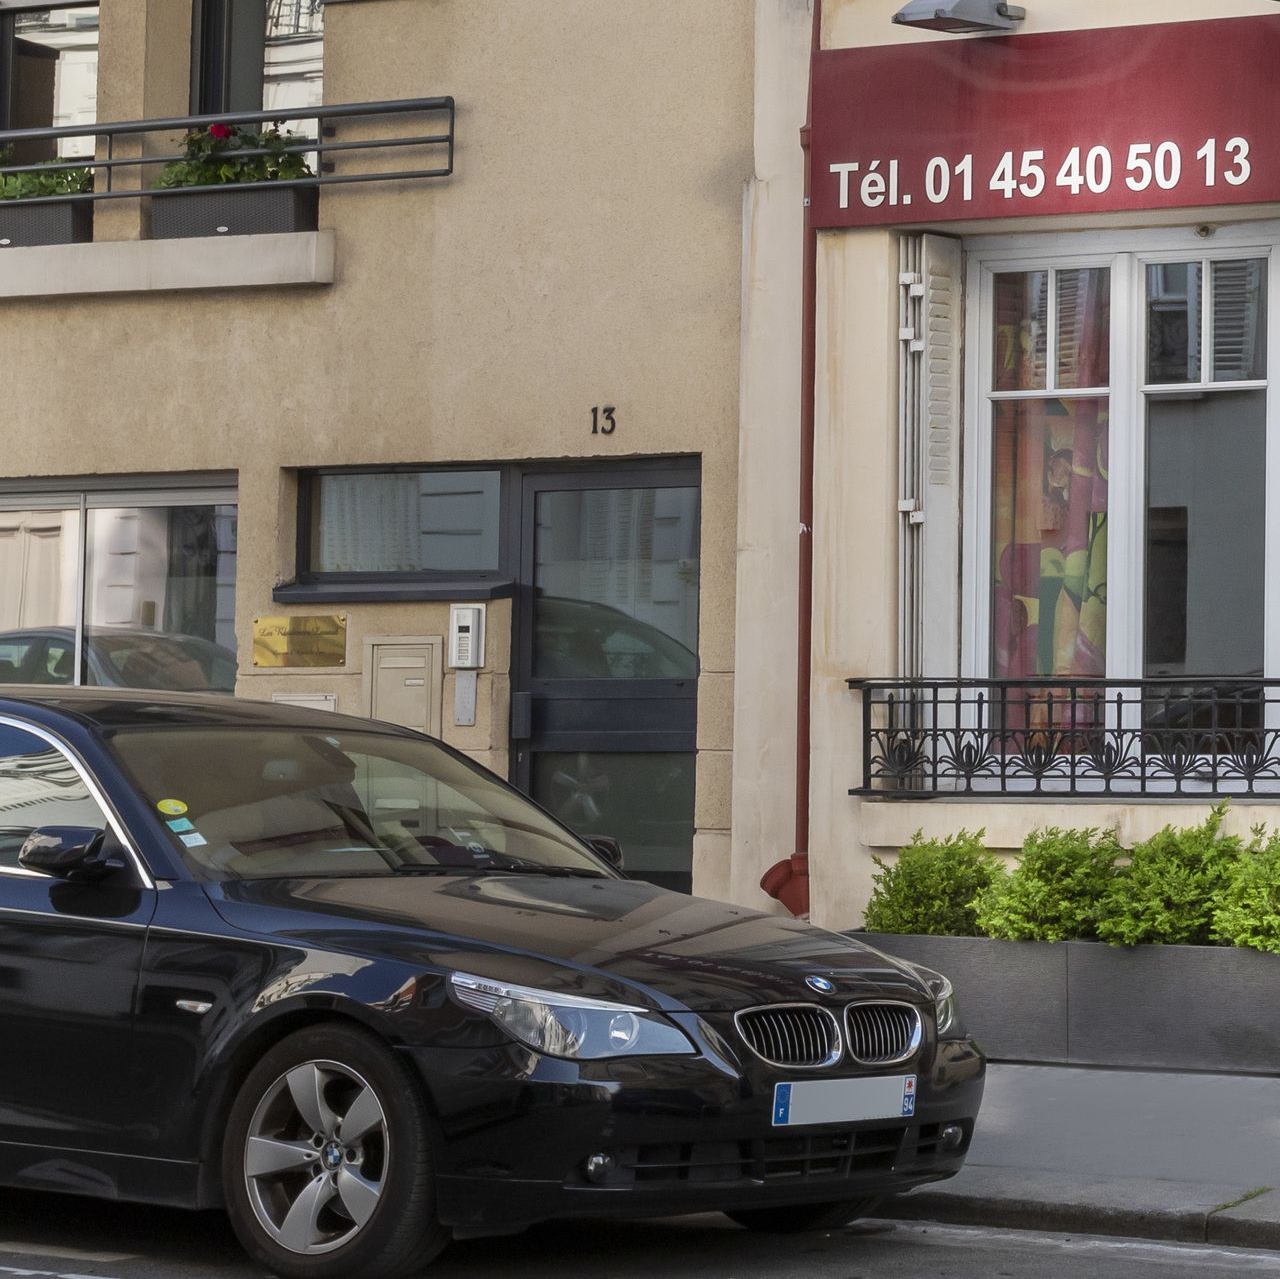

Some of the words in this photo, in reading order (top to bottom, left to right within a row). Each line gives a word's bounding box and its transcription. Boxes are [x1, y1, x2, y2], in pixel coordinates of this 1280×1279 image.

[829, 158, 912, 209] Tél.
[924, 153, 975, 204] 01
[988, 148, 1047, 199] 45
[1055, 144, 1113, 195] 40
[1125, 139, 1182, 192] 50
[1196, 135, 1252, 187] 13
[591, 406, 616, 435] 13
[778, 1107, 785, 1118] F
[903, 1096, 914, 1112] 94
